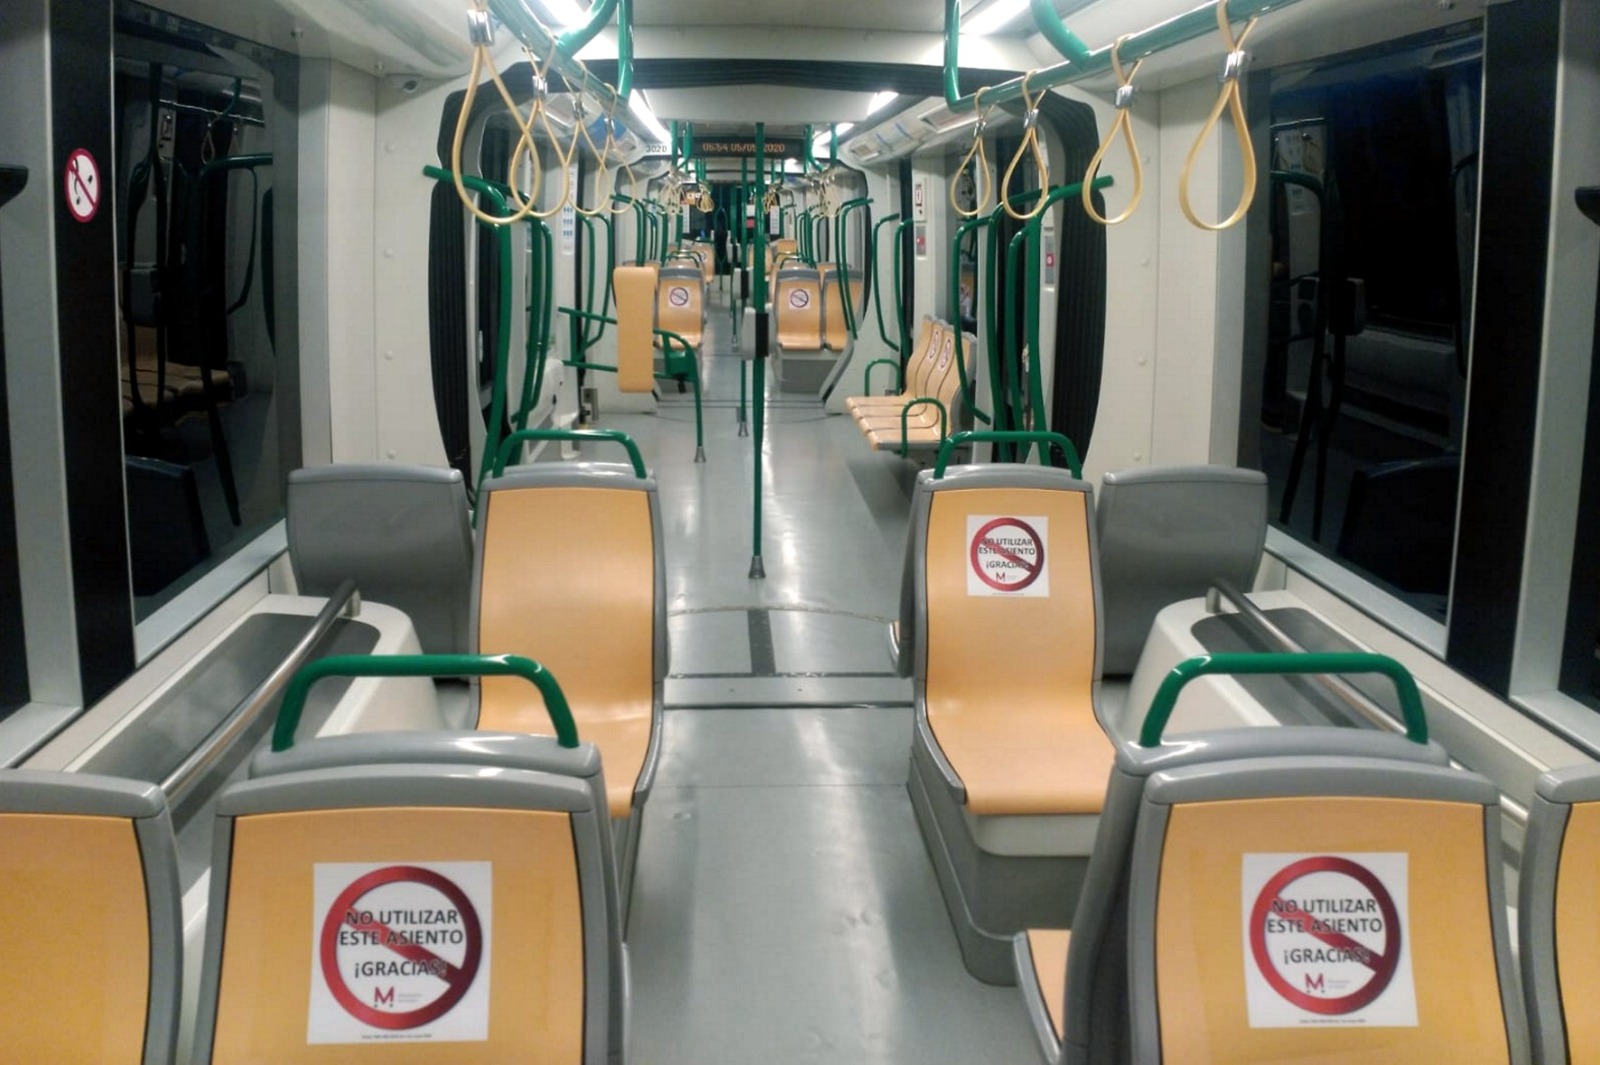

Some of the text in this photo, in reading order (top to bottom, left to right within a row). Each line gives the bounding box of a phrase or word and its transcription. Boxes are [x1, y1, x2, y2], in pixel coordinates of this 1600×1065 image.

[730, 142, 785, 153] 05/052020
[996, 538, 1033, 546] UTILIZAR
[1272, 898, 1377, 914] NO UTILIZAR
[346, 909, 458, 925] NO UTILIZAR
[1266, 917, 1383, 934] ESTE ASIENTO
[339, 929, 464, 946] ESTE ASIENTO
